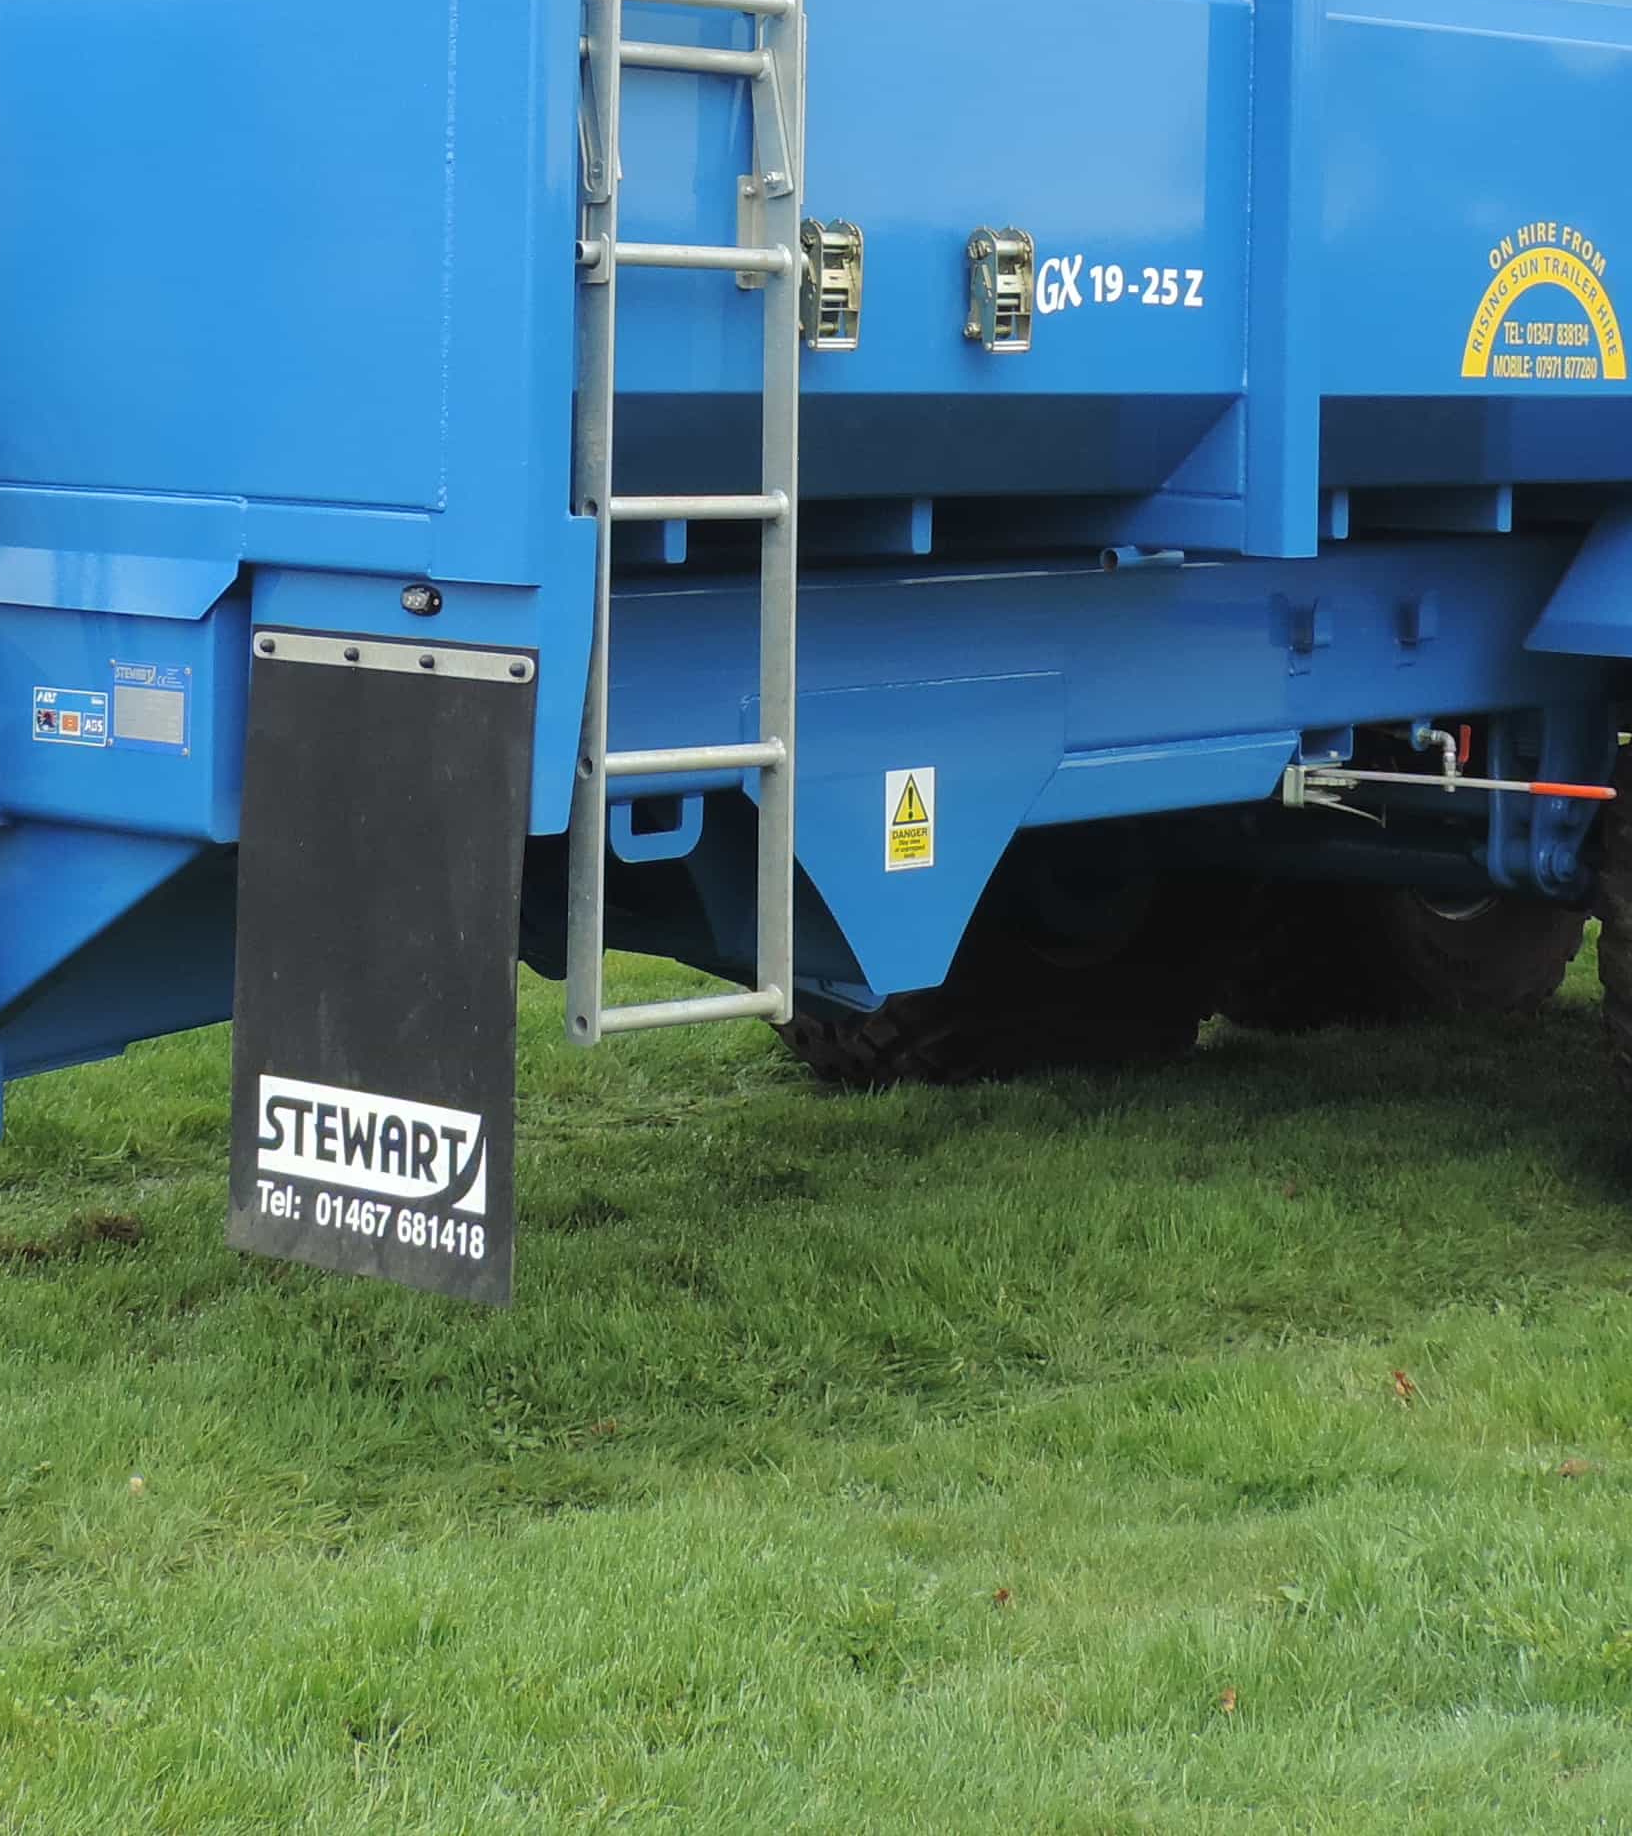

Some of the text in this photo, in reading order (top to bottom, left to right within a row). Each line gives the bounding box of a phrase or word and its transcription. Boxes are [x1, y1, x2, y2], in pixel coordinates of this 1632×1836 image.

[1489, 222, 1607, 276] ON HIRE FROM
[1036, 254, 1082, 314] GX
[1472, 256, 1618, 357] RISING SUN TRAILER HIRE
[1504, 322, 1524, 344] TEL:
[1493, 355, 1532, 378] MOBILE:
[892, 827, 928, 840] DANGER
[258, 1095, 486, 1207] STEWART
[257, 1180, 485, 1259] Tel: 01467 681418
